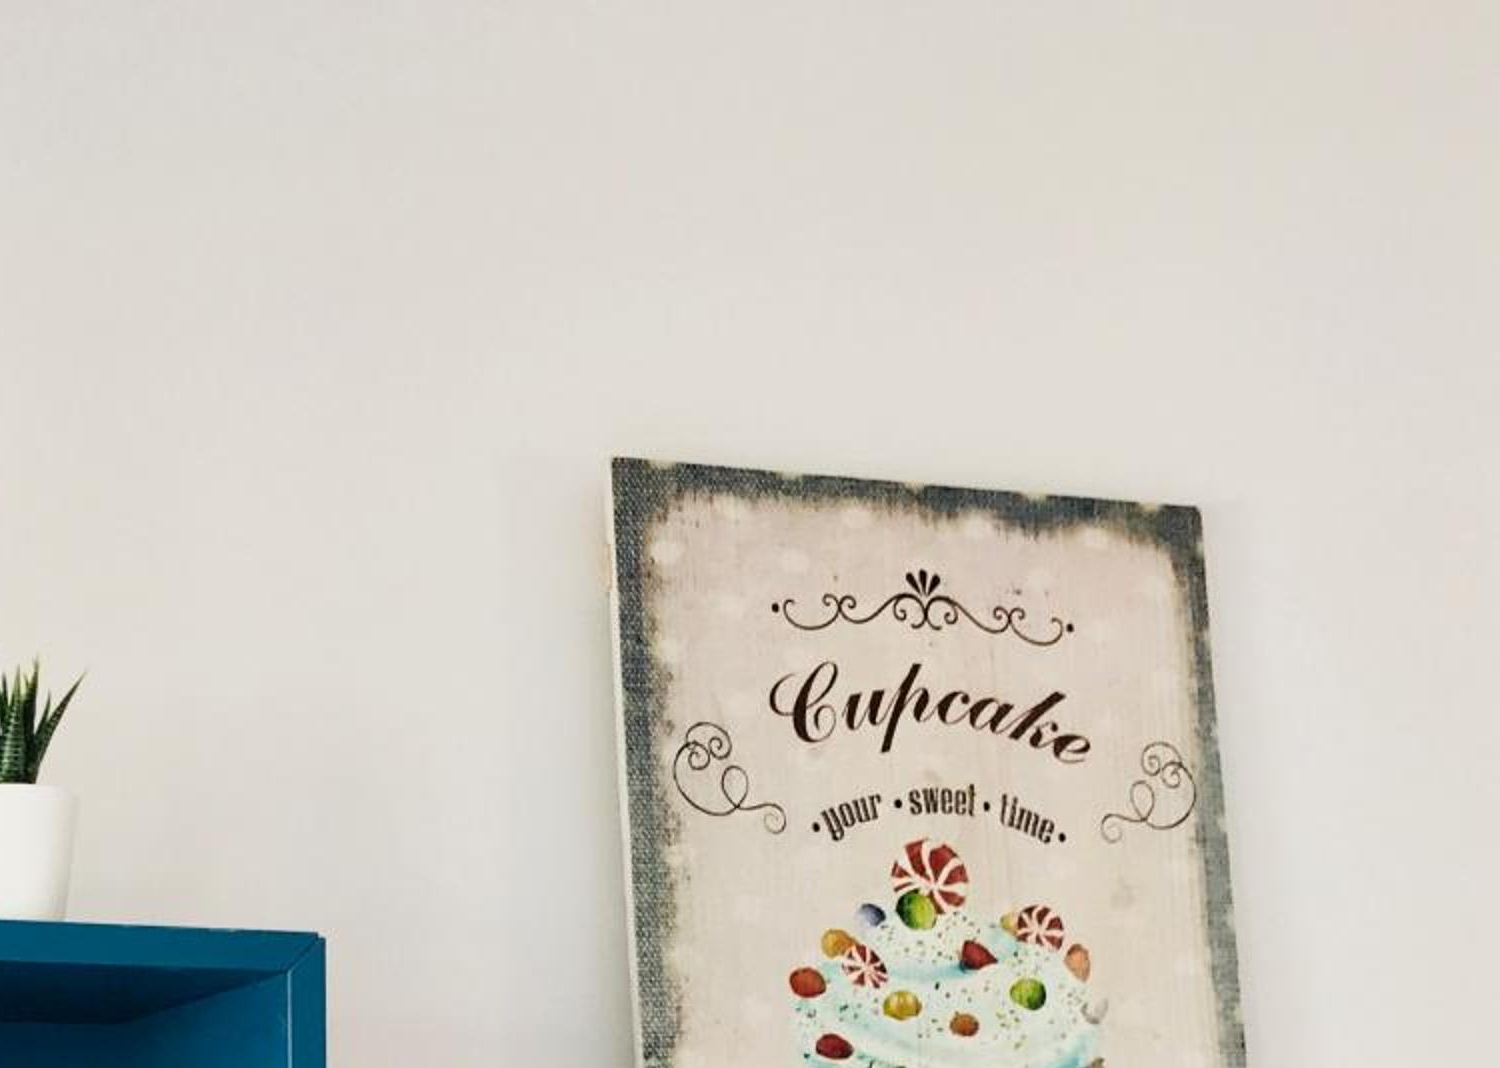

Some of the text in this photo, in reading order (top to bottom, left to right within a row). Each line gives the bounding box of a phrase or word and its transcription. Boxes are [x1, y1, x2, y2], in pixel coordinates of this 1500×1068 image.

[769, 661, 1091, 763] Cupcake
[821, 783, 1055, 844] your sweet time
